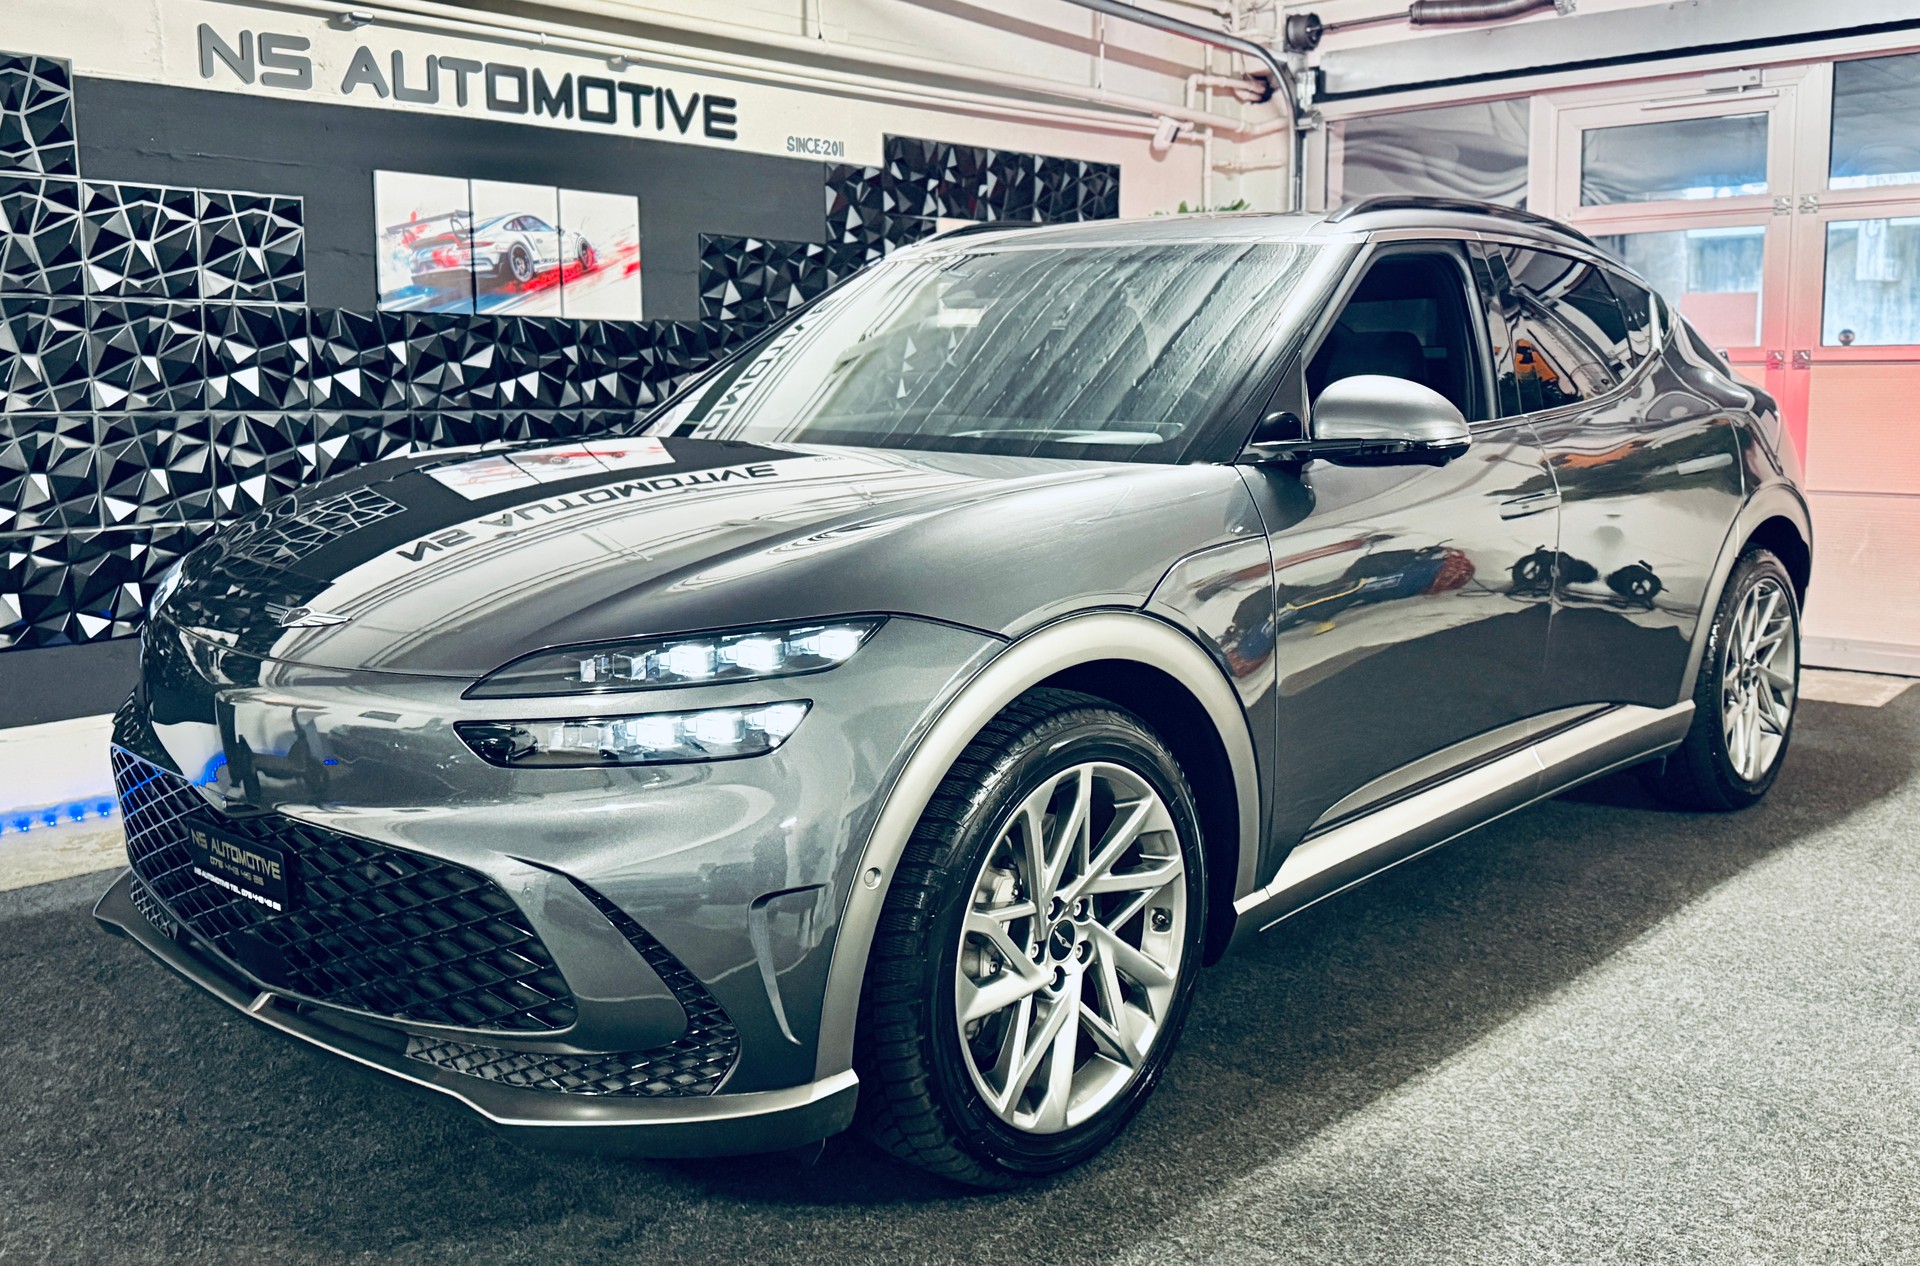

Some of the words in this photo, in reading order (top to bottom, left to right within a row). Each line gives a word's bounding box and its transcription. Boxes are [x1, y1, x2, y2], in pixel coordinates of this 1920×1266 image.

[198, 22, 312, 91] NS
[341, 45, 738, 142] AUTOMOTIVE
[190, 827, 208, 850] NS
[211, 836, 282, 881] AUTOMOTIVE
